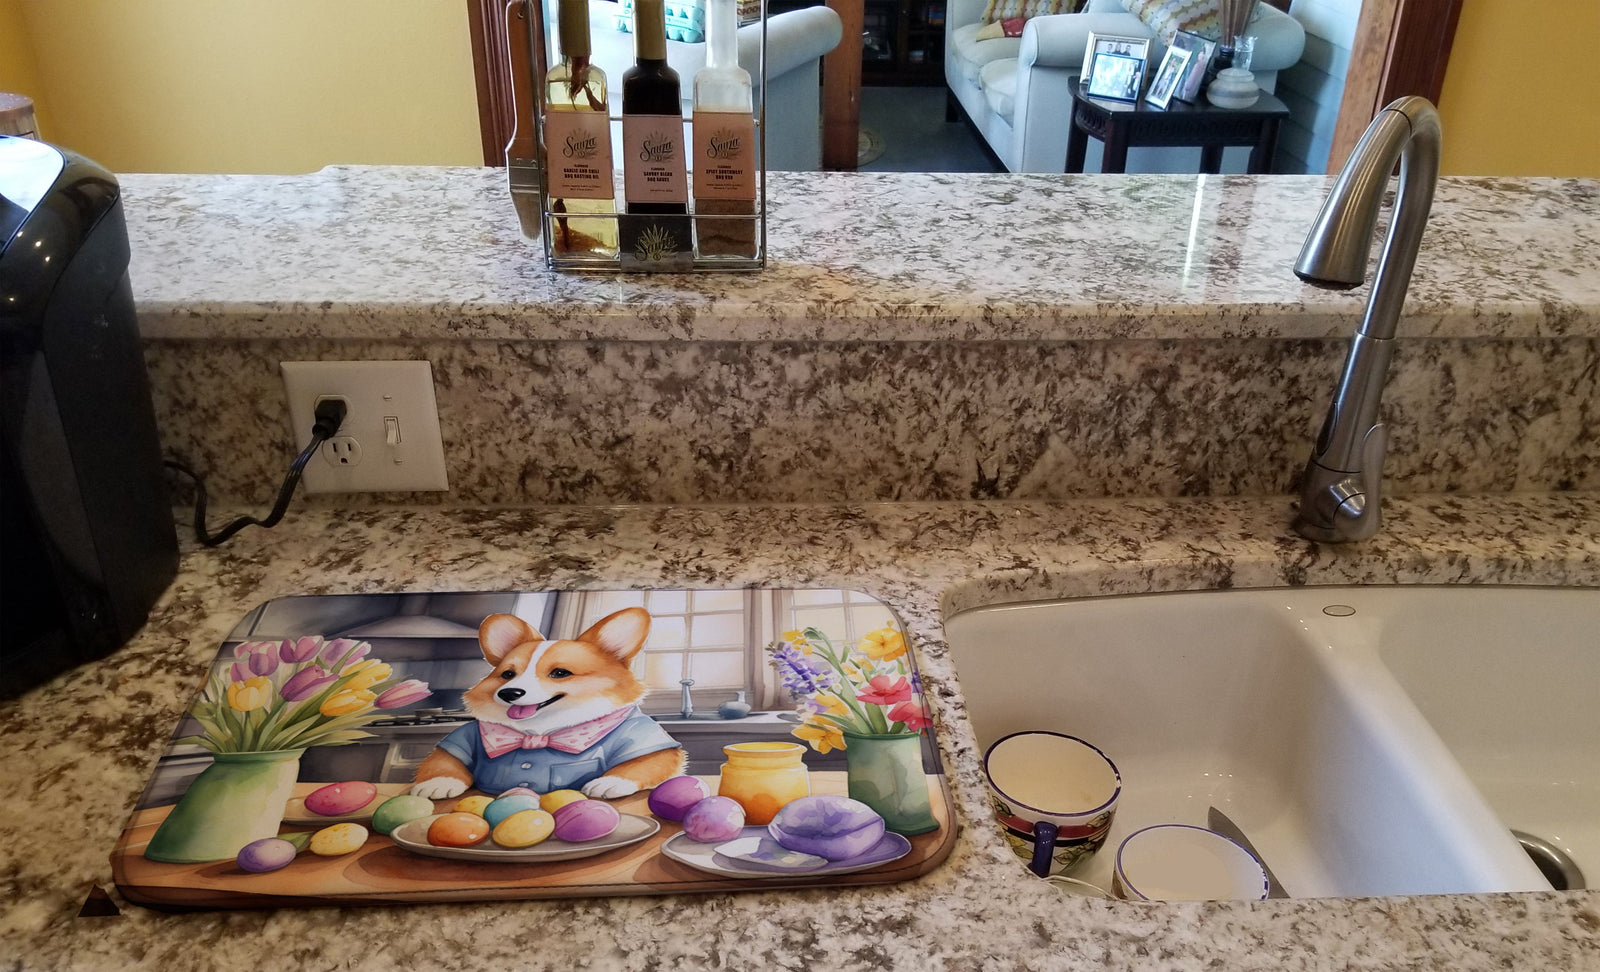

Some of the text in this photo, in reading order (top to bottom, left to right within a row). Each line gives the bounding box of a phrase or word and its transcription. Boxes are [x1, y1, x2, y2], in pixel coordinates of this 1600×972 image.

[562, 135, 598, 158] Sauza
[640, 140, 673, 162] Sauza
[706, 136, 740, 159] Sauza
